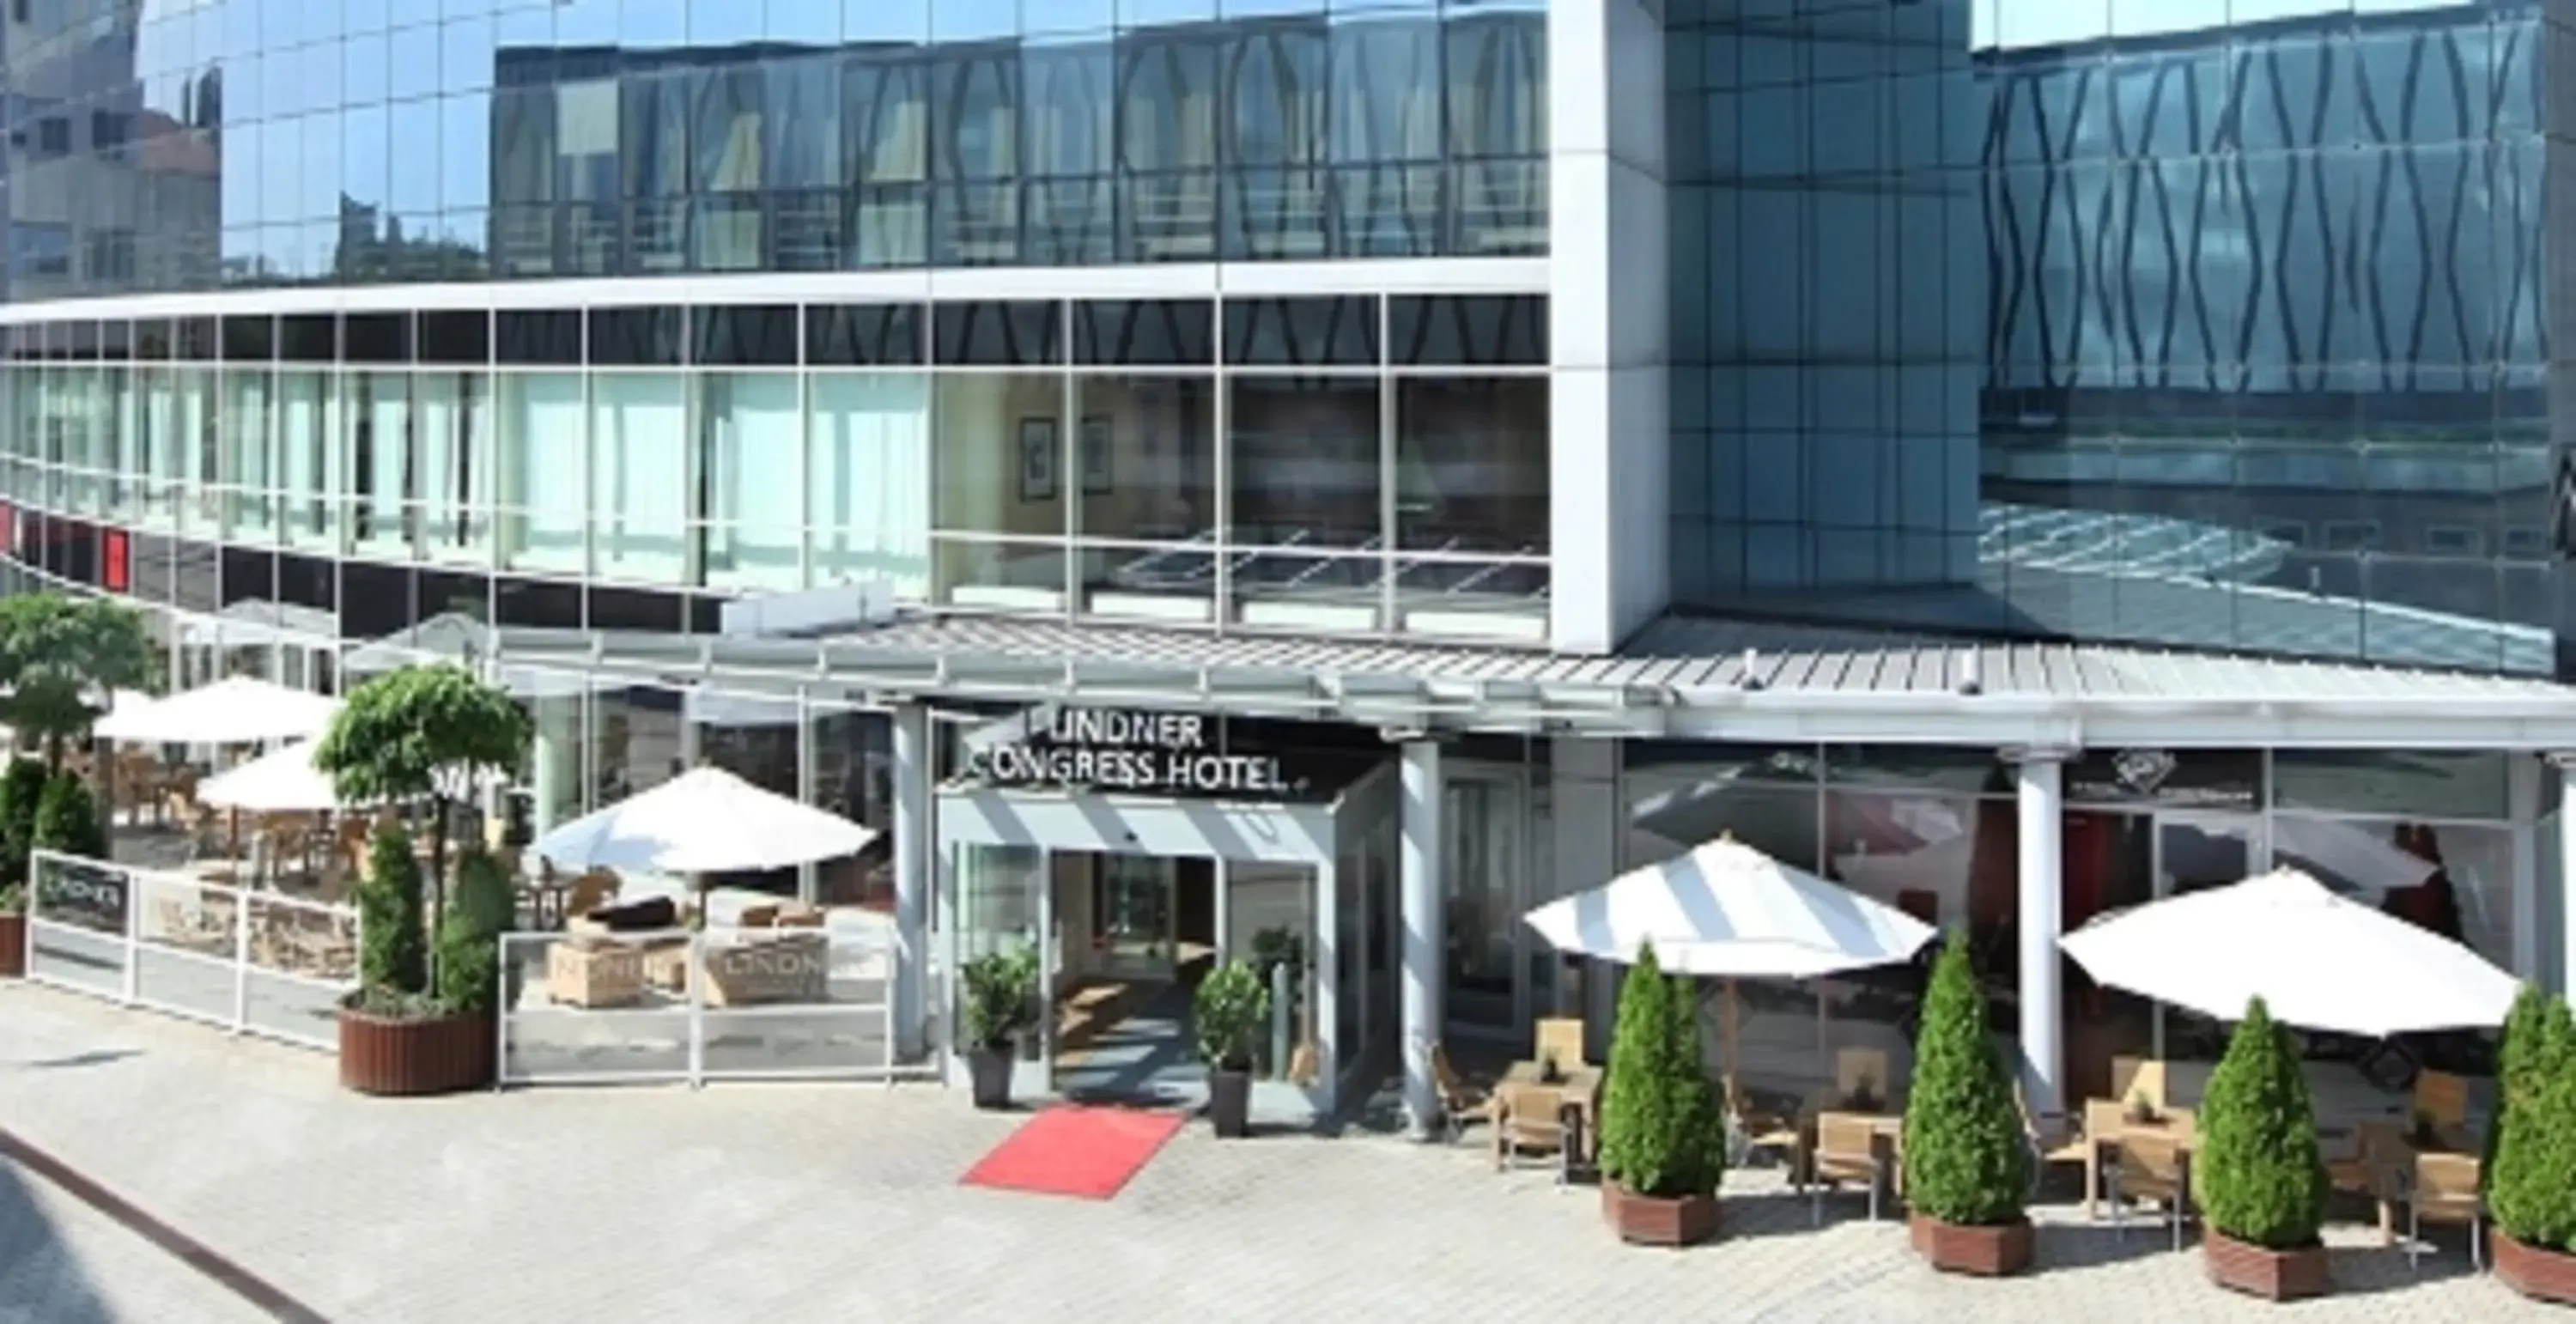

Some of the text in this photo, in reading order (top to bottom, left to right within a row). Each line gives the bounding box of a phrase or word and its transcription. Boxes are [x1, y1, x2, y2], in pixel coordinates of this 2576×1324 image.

[1050, 709, 1203, 748] LINDNER
[970, 744, 1288, 789] CONGRESS HOTEL
[726, 951, 859, 976] LINDN
